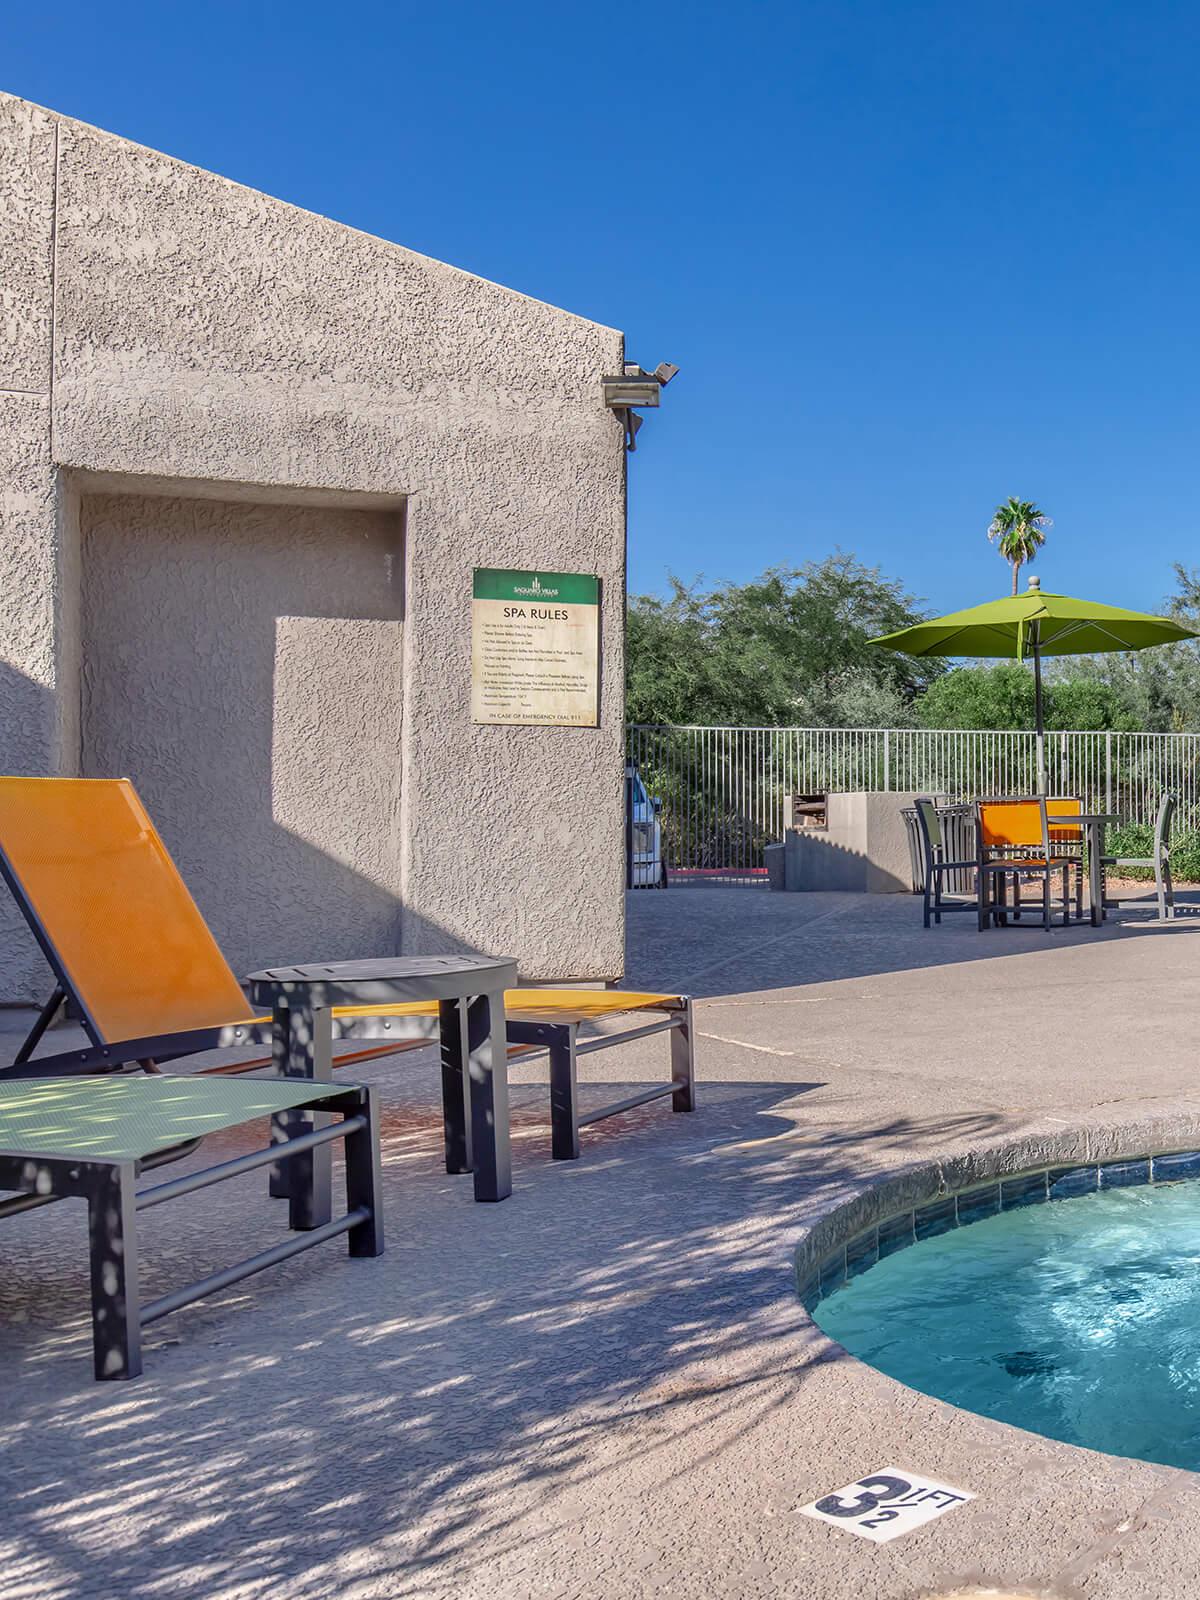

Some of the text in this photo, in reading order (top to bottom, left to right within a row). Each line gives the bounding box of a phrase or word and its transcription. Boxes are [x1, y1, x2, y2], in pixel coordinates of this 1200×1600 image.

[503, 607, 569, 620] SPA RULES
[815, 1475, 912, 1518] 3
